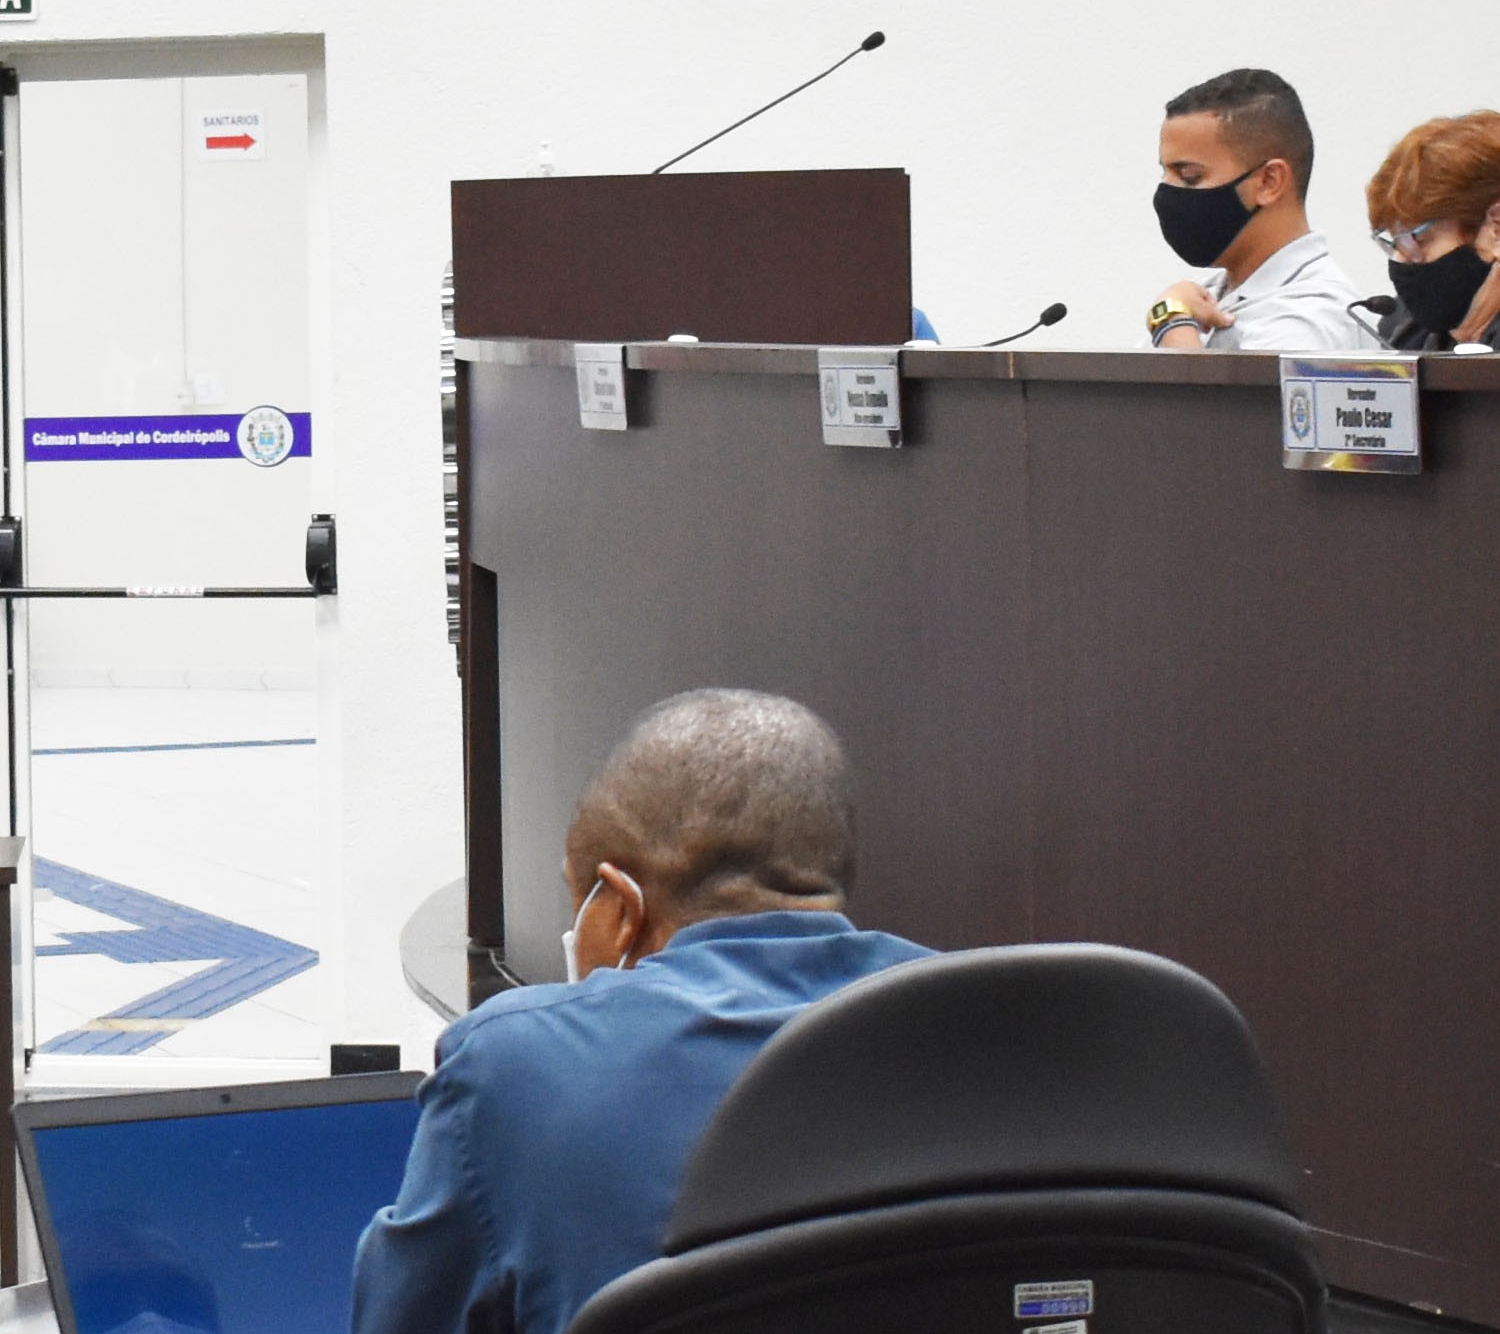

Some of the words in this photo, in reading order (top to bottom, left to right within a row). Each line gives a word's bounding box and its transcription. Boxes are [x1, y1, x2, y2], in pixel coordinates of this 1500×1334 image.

[1336, 407, 1363, 427] Paulo
[32, 432, 76, 446] Câmara
[78, 430, 134, 447] Municipal
[136, 431, 150, 444] de
[152, 429, 230, 447] Cordeirópolis
